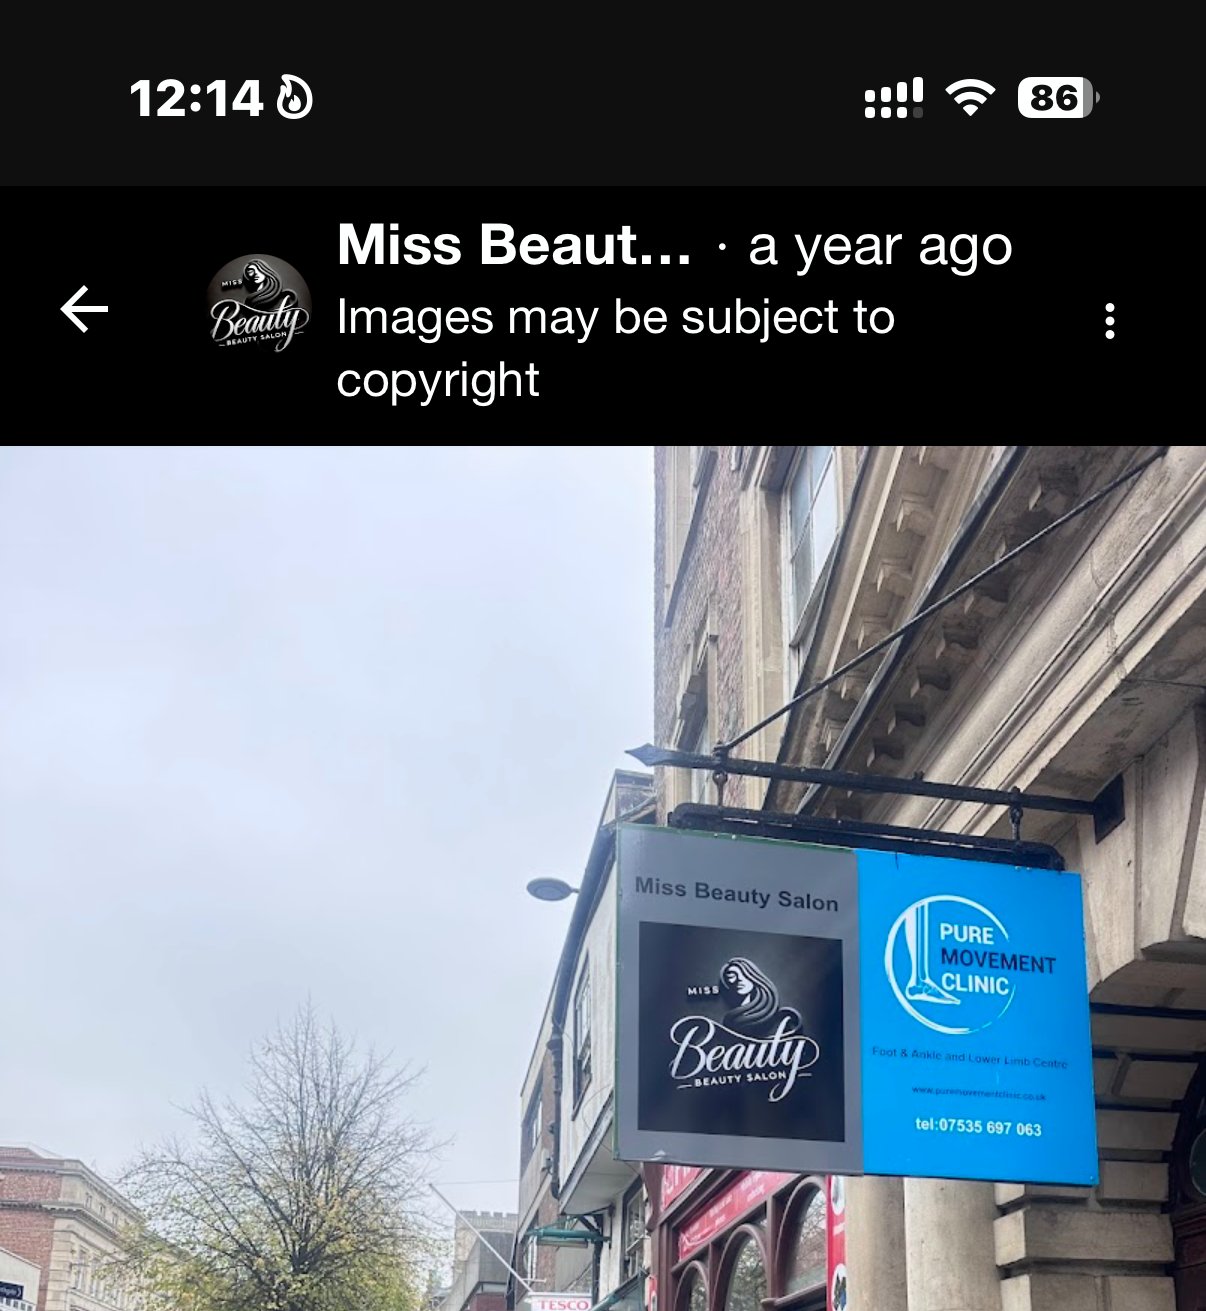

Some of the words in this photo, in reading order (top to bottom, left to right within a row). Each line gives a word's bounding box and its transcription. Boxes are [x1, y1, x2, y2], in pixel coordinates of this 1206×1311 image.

[635, 876, 687, 897] Miss
[695, 882, 771, 909] Beauty
[778, 890, 839, 912] Salon
[940, 923, 994, 945] PURE
[941, 948, 1057, 974] MOVEMENT
[688, 986, 720, 995] MISS
[941, 973, 1009, 995] CLINIC
[669, 1007, 819, 1102] Beauty
[872, 1047, 897, 1057] Foot
[901, 1049, 908, 1057] &
[912, 1049, 941, 1060] Ankle
[945, 1052, 965, 1062] and
[968, 1053, 1000, 1064] Lower
[1004, 1055, 1030, 1067] Limb
[1033, 1058, 1068, 1069] Centre
[694, 1074, 741, 1087] BEAUTY
[746, 1070, 787, 1081] SALON
[915, 1117, 982, 1133] tel:07535
[986, 1120, 1012, 1135] 697
[1016, 1123, 1042, 1136] 063
[540, 1300, 589, 1311] TESCO
